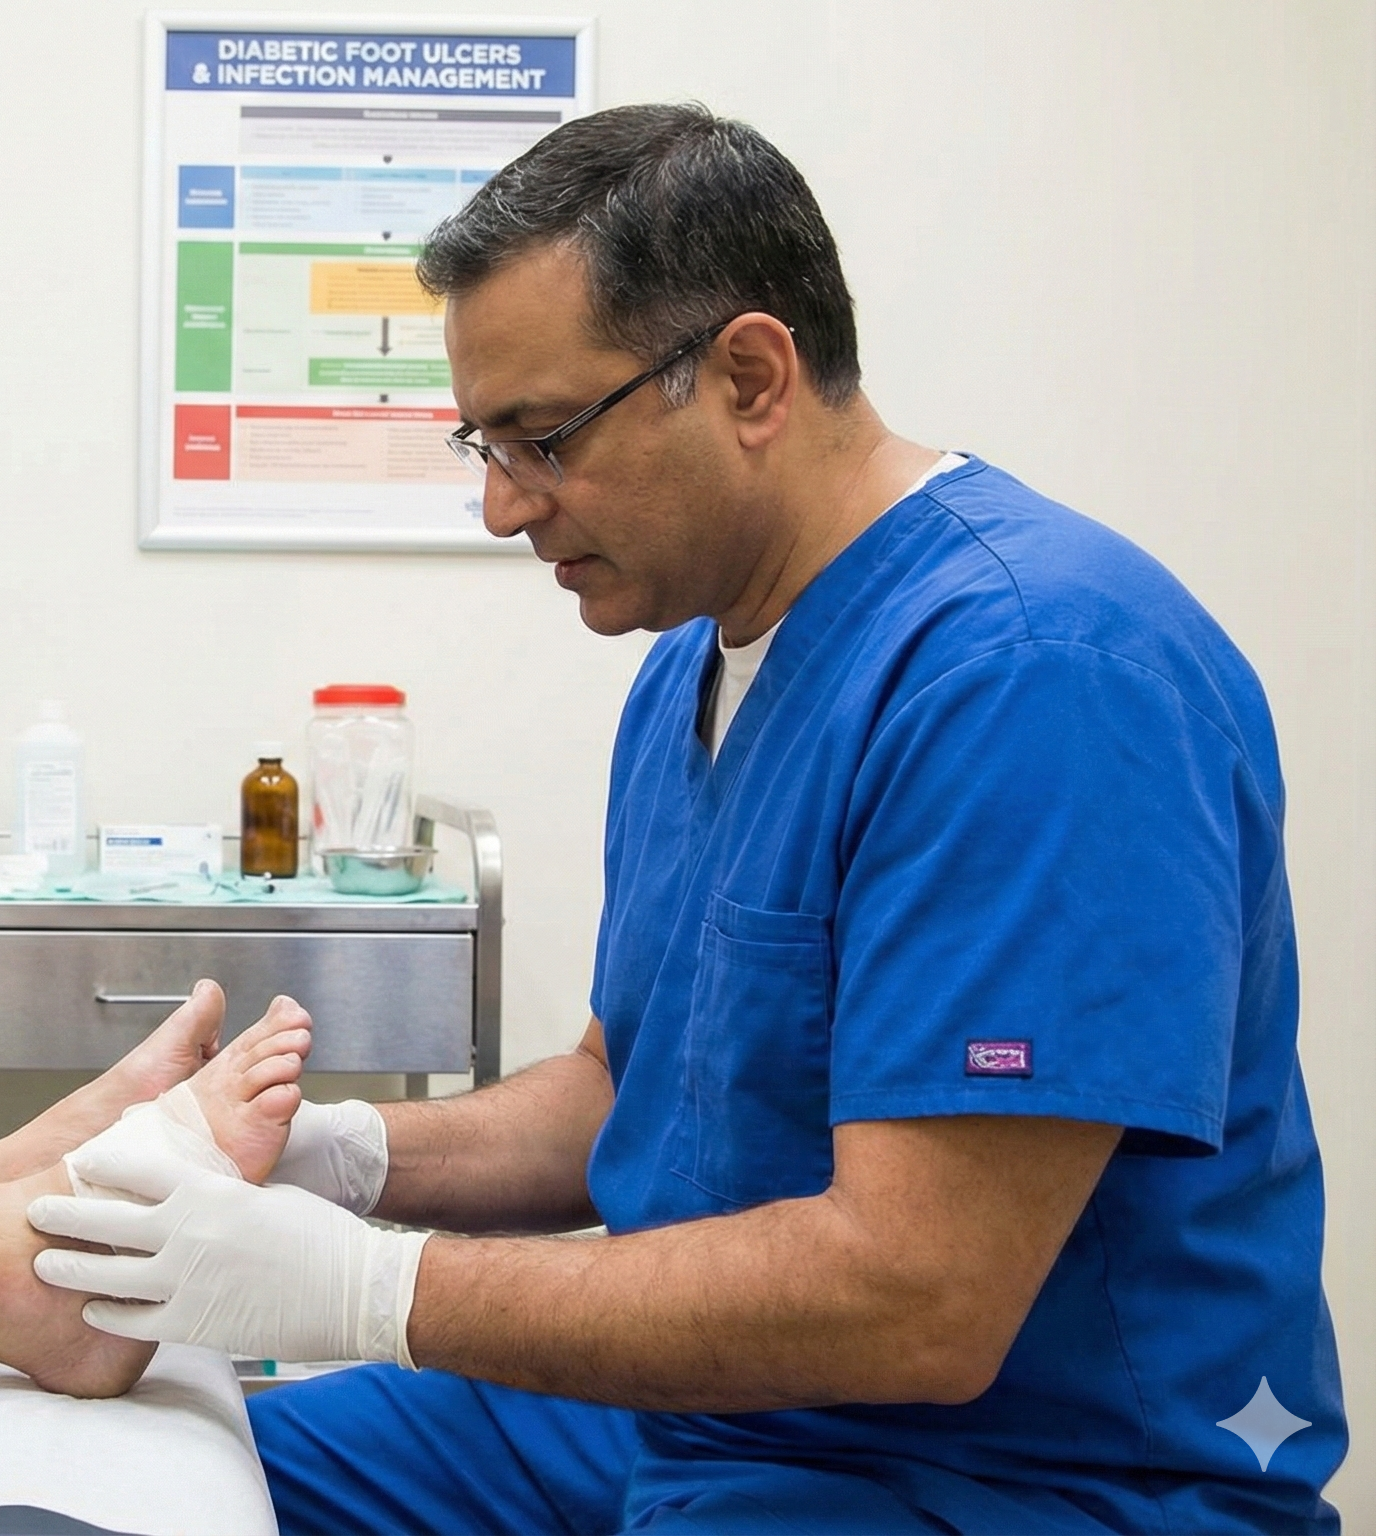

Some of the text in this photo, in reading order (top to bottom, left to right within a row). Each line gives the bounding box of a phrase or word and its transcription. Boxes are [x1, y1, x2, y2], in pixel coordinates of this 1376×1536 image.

[218, 39, 521, 65] DIABETIC FOOT ULCERS
[192, 63, 545, 89] & INFECTION MANAGEMENT
